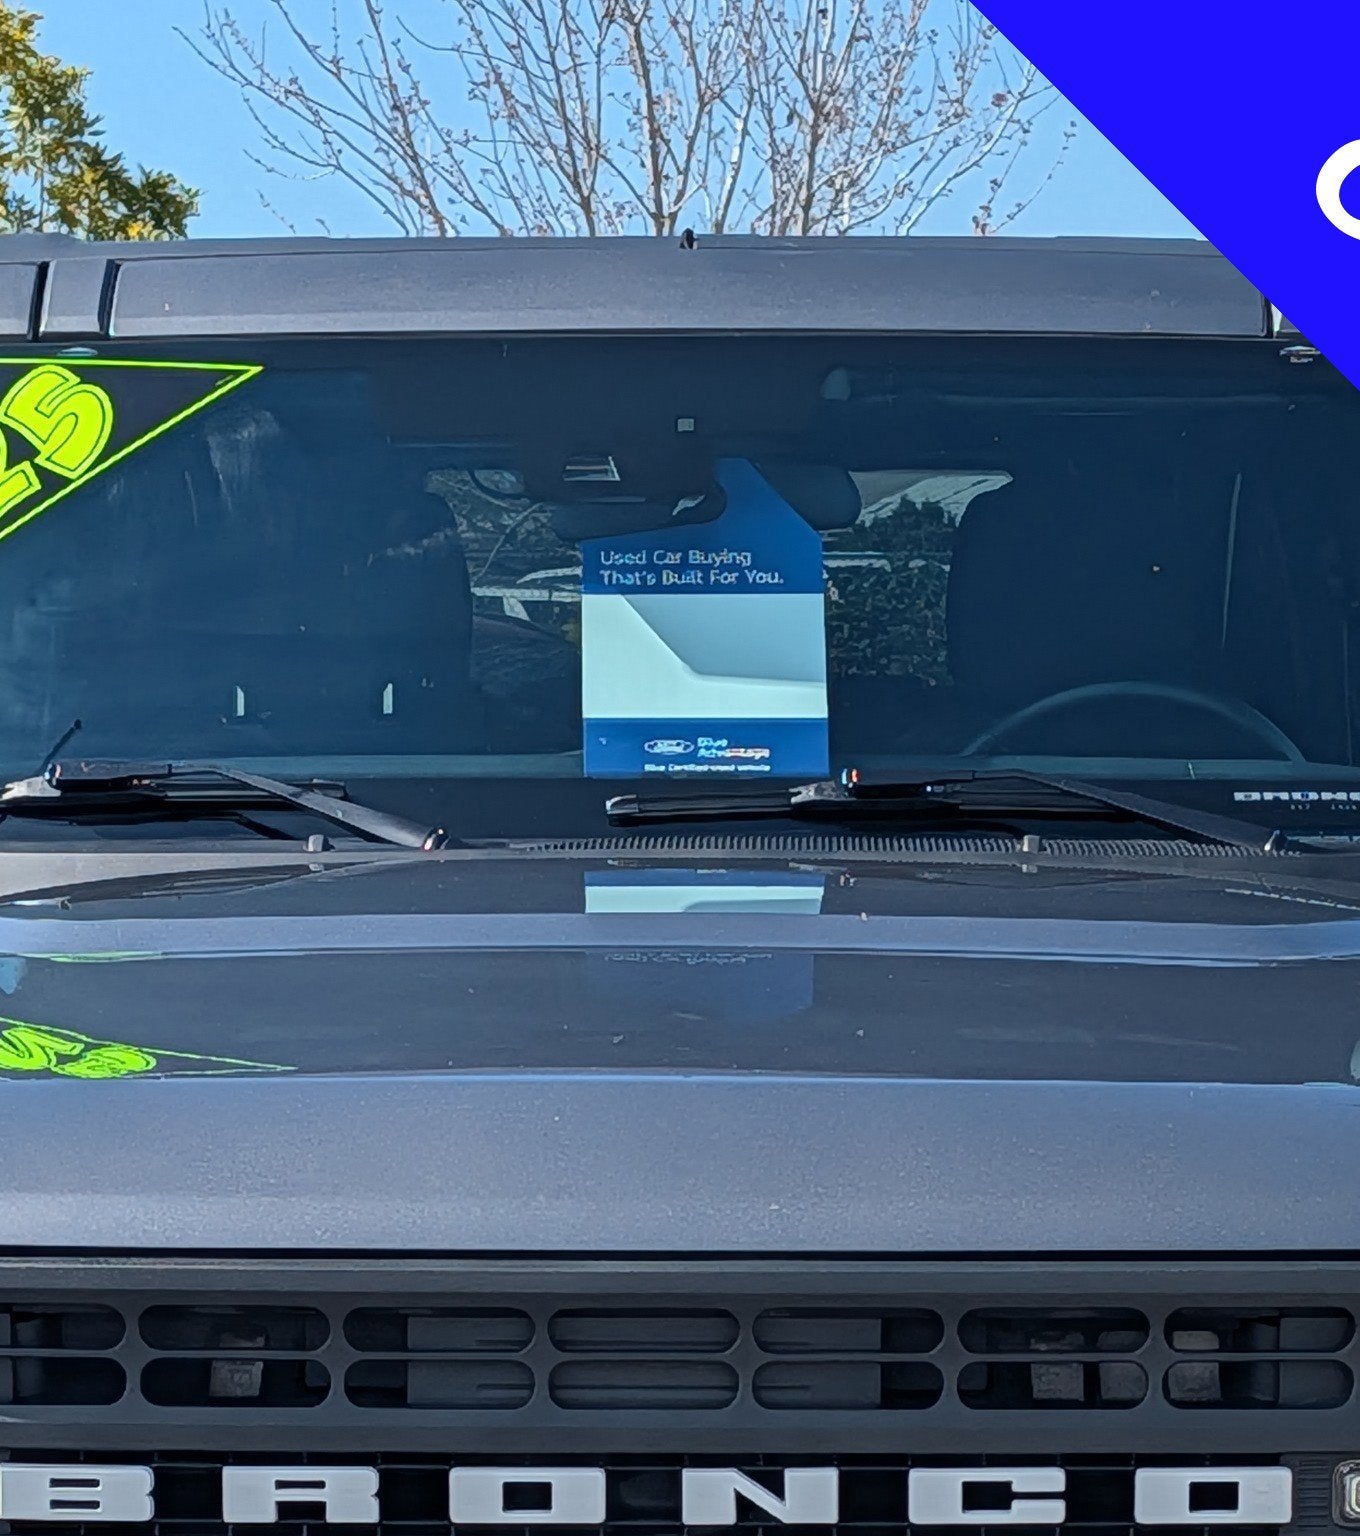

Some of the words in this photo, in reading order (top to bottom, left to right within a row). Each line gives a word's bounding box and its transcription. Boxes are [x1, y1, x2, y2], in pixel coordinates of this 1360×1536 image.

[599, 549, 647, 565] Used
[653, 550, 682, 565] Car
[688, 548, 752, 567] Buying
[599, 569, 656, 586] That's
[662, 569, 704, 586] Built
[709, 570, 739, 585] For
[744, 569, 785, 585] You.
